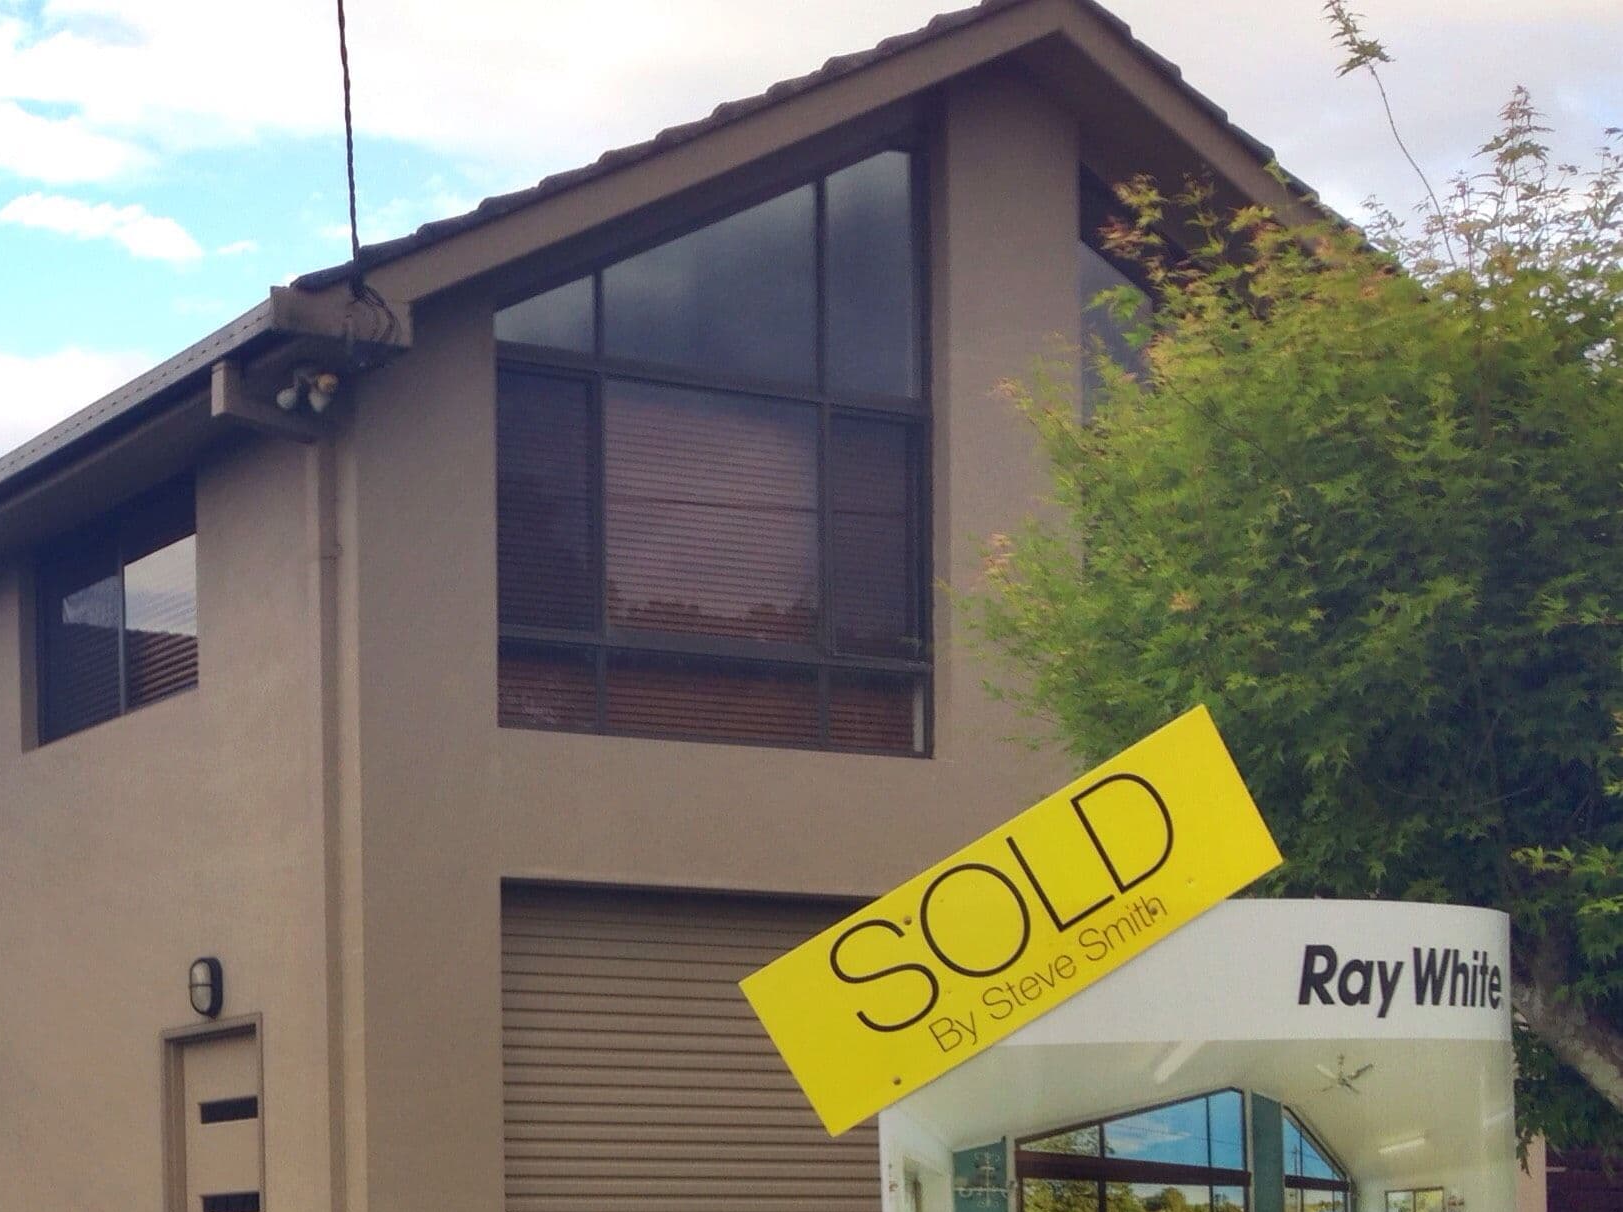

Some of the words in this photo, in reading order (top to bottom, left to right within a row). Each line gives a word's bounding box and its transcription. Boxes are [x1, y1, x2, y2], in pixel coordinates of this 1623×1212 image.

[830, 773, 1174, 1032] SOLD
[928, 1011, 978, 1052] By
[982, 954, 1076, 1019] Steve
[1078, 896, 1168, 961] Smith
[1298, 945, 1404, 1018] Ray
[1413, 947, 1501, 1009] White
